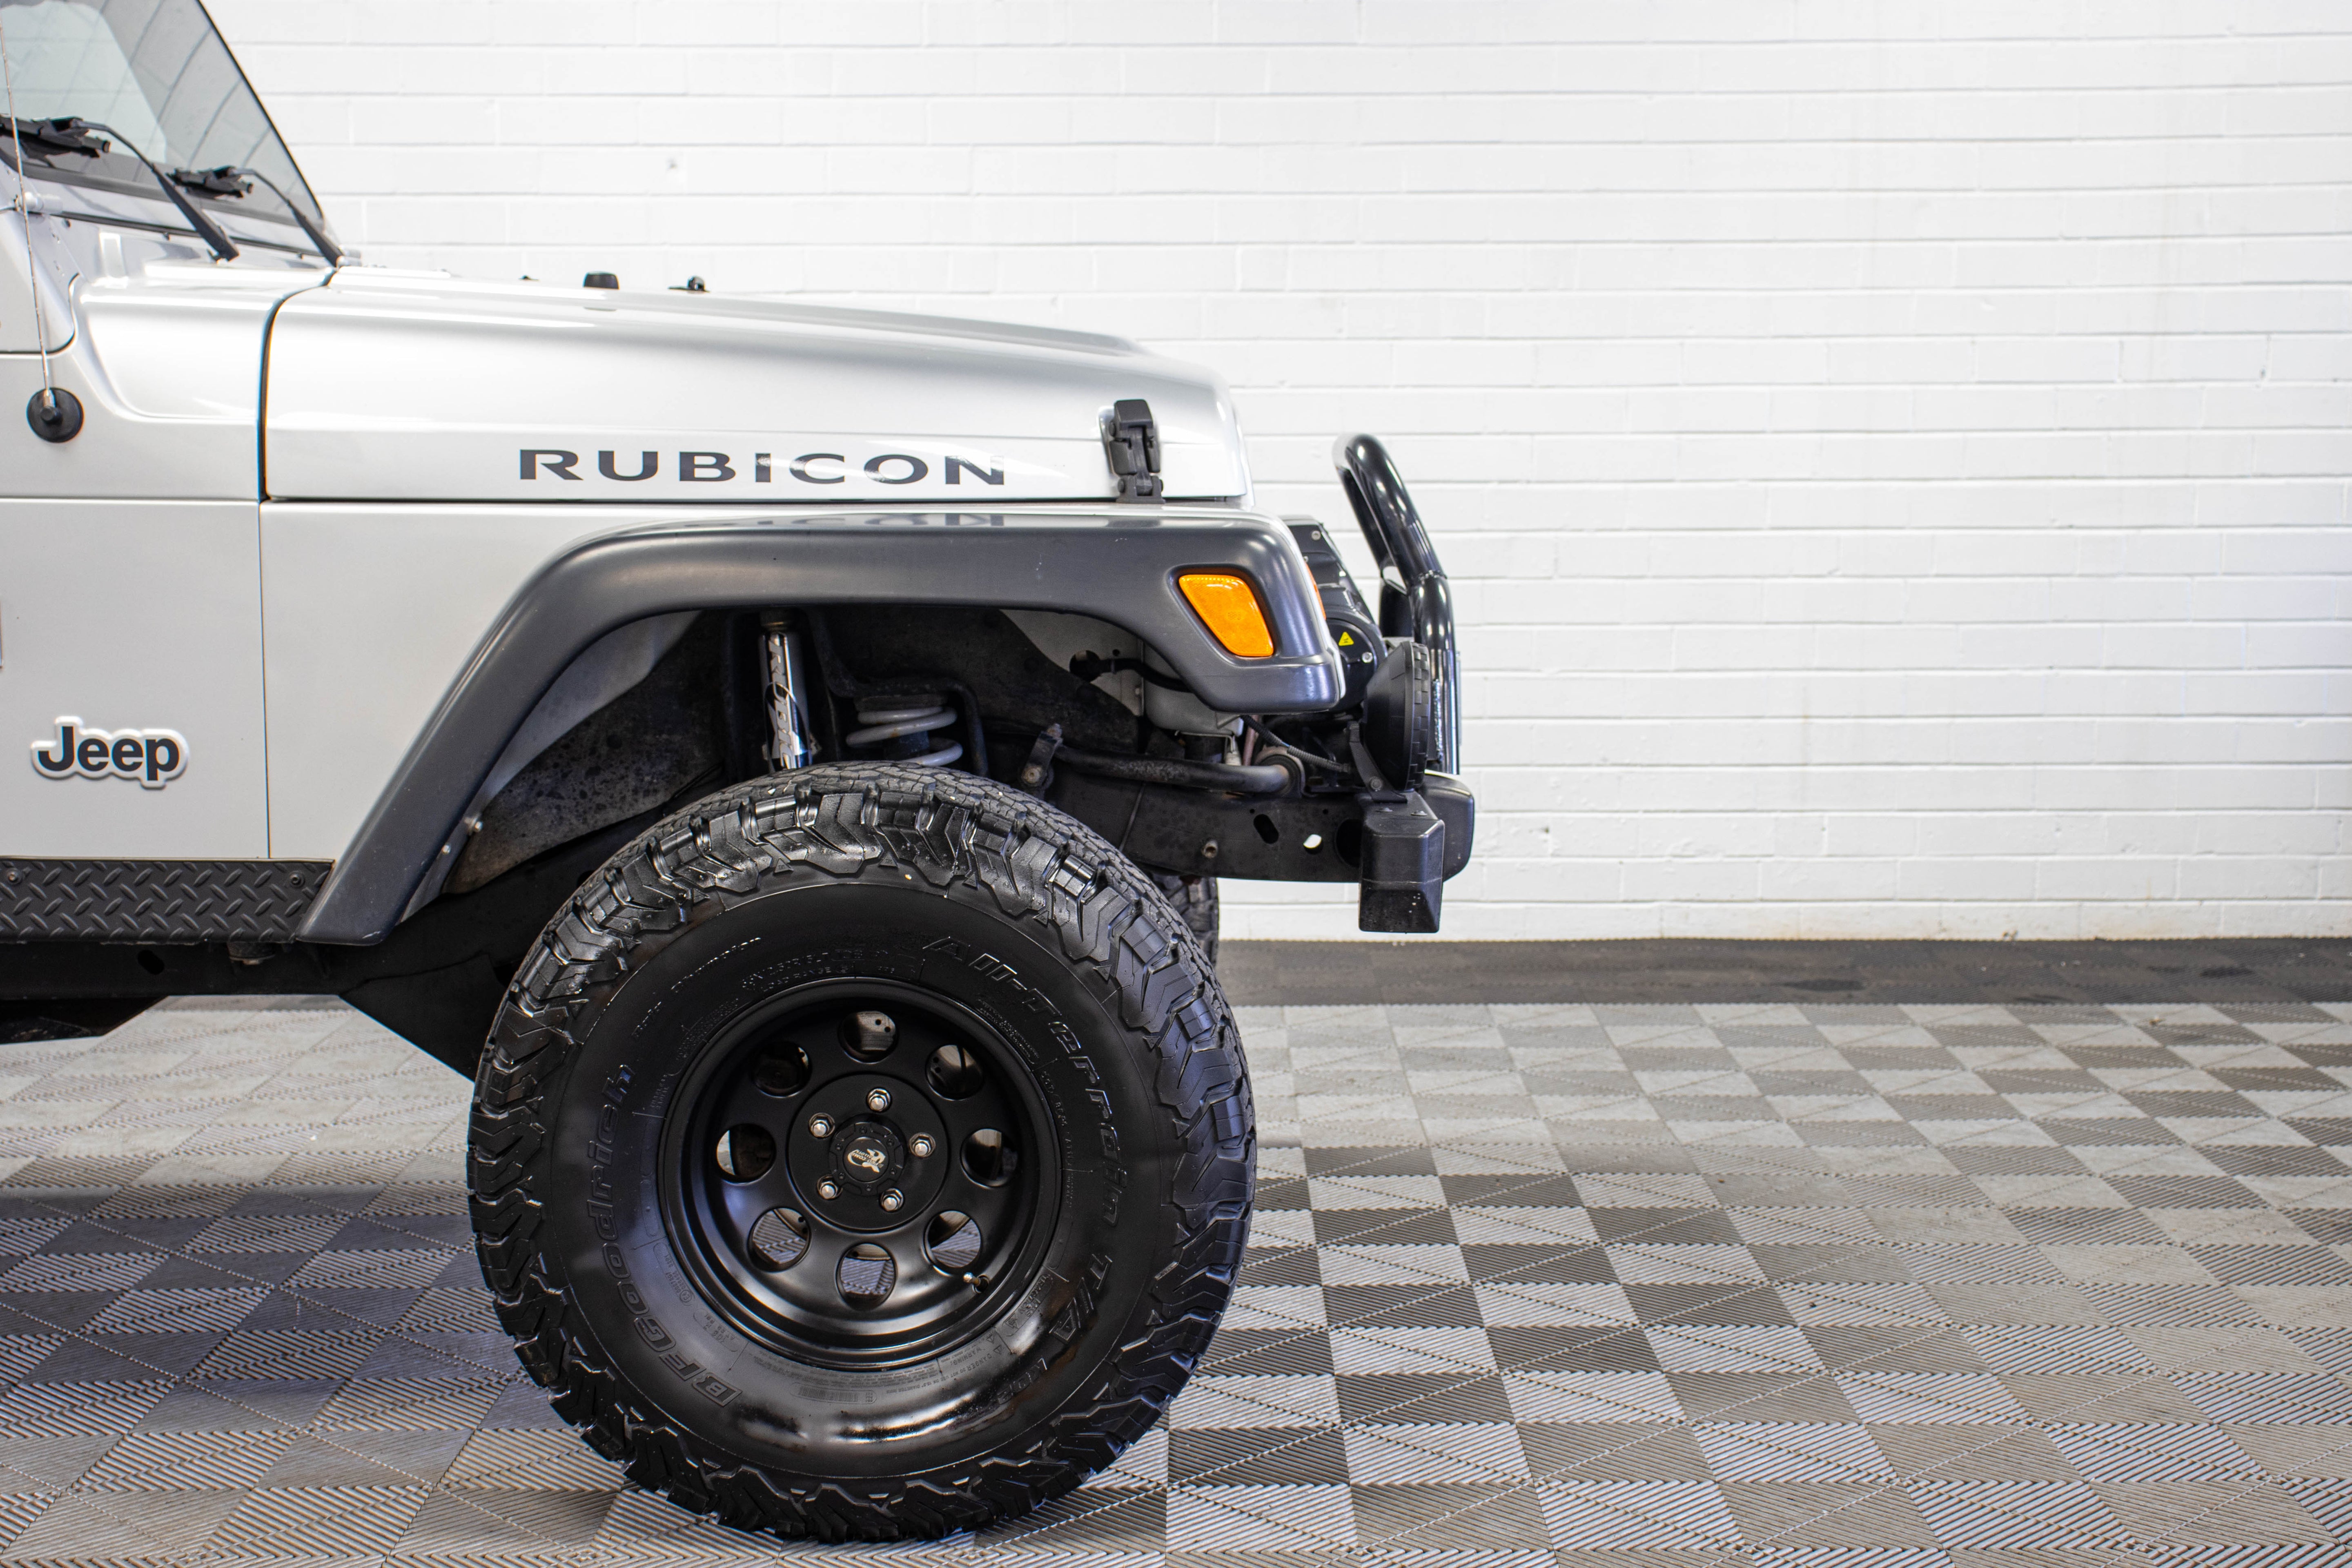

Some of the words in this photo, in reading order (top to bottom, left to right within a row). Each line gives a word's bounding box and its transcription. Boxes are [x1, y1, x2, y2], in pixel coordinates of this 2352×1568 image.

[519, 448, 1005, 486] RUBICON
[38, 725, 180, 781] Jeep
[851, 1152, 866, 1161] COMP
[922, 936, 1125, 1227] All-Terrain
[1049, 1252, 1113, 1343] T/A
[589, 1062, 742, 1408] BFGoodrich
